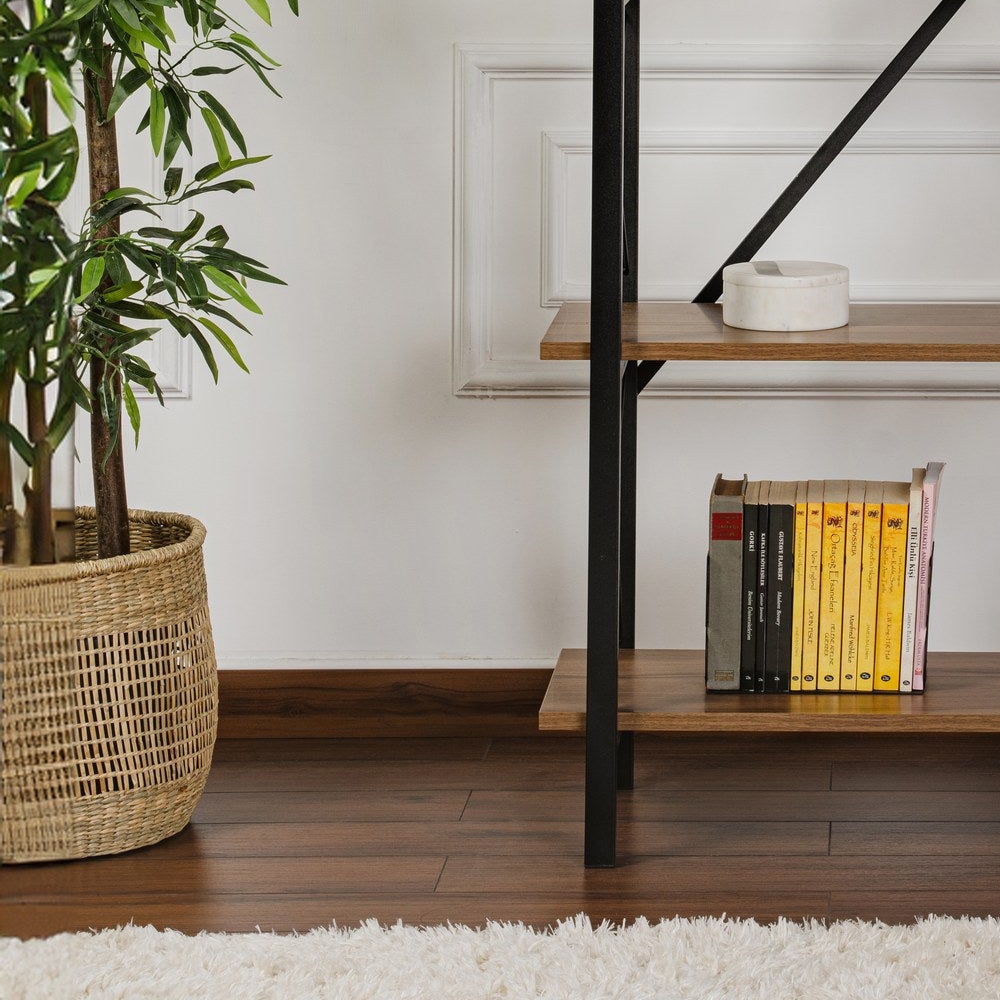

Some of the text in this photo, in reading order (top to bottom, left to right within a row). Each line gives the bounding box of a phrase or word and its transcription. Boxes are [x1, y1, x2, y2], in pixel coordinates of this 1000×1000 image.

[909, 541, 919, 562] Ünlü
[809, 565, 818, 590] England
[907, 563, 916, 578] Kişi
[829, 571, 839, 613] Efsaneleri
